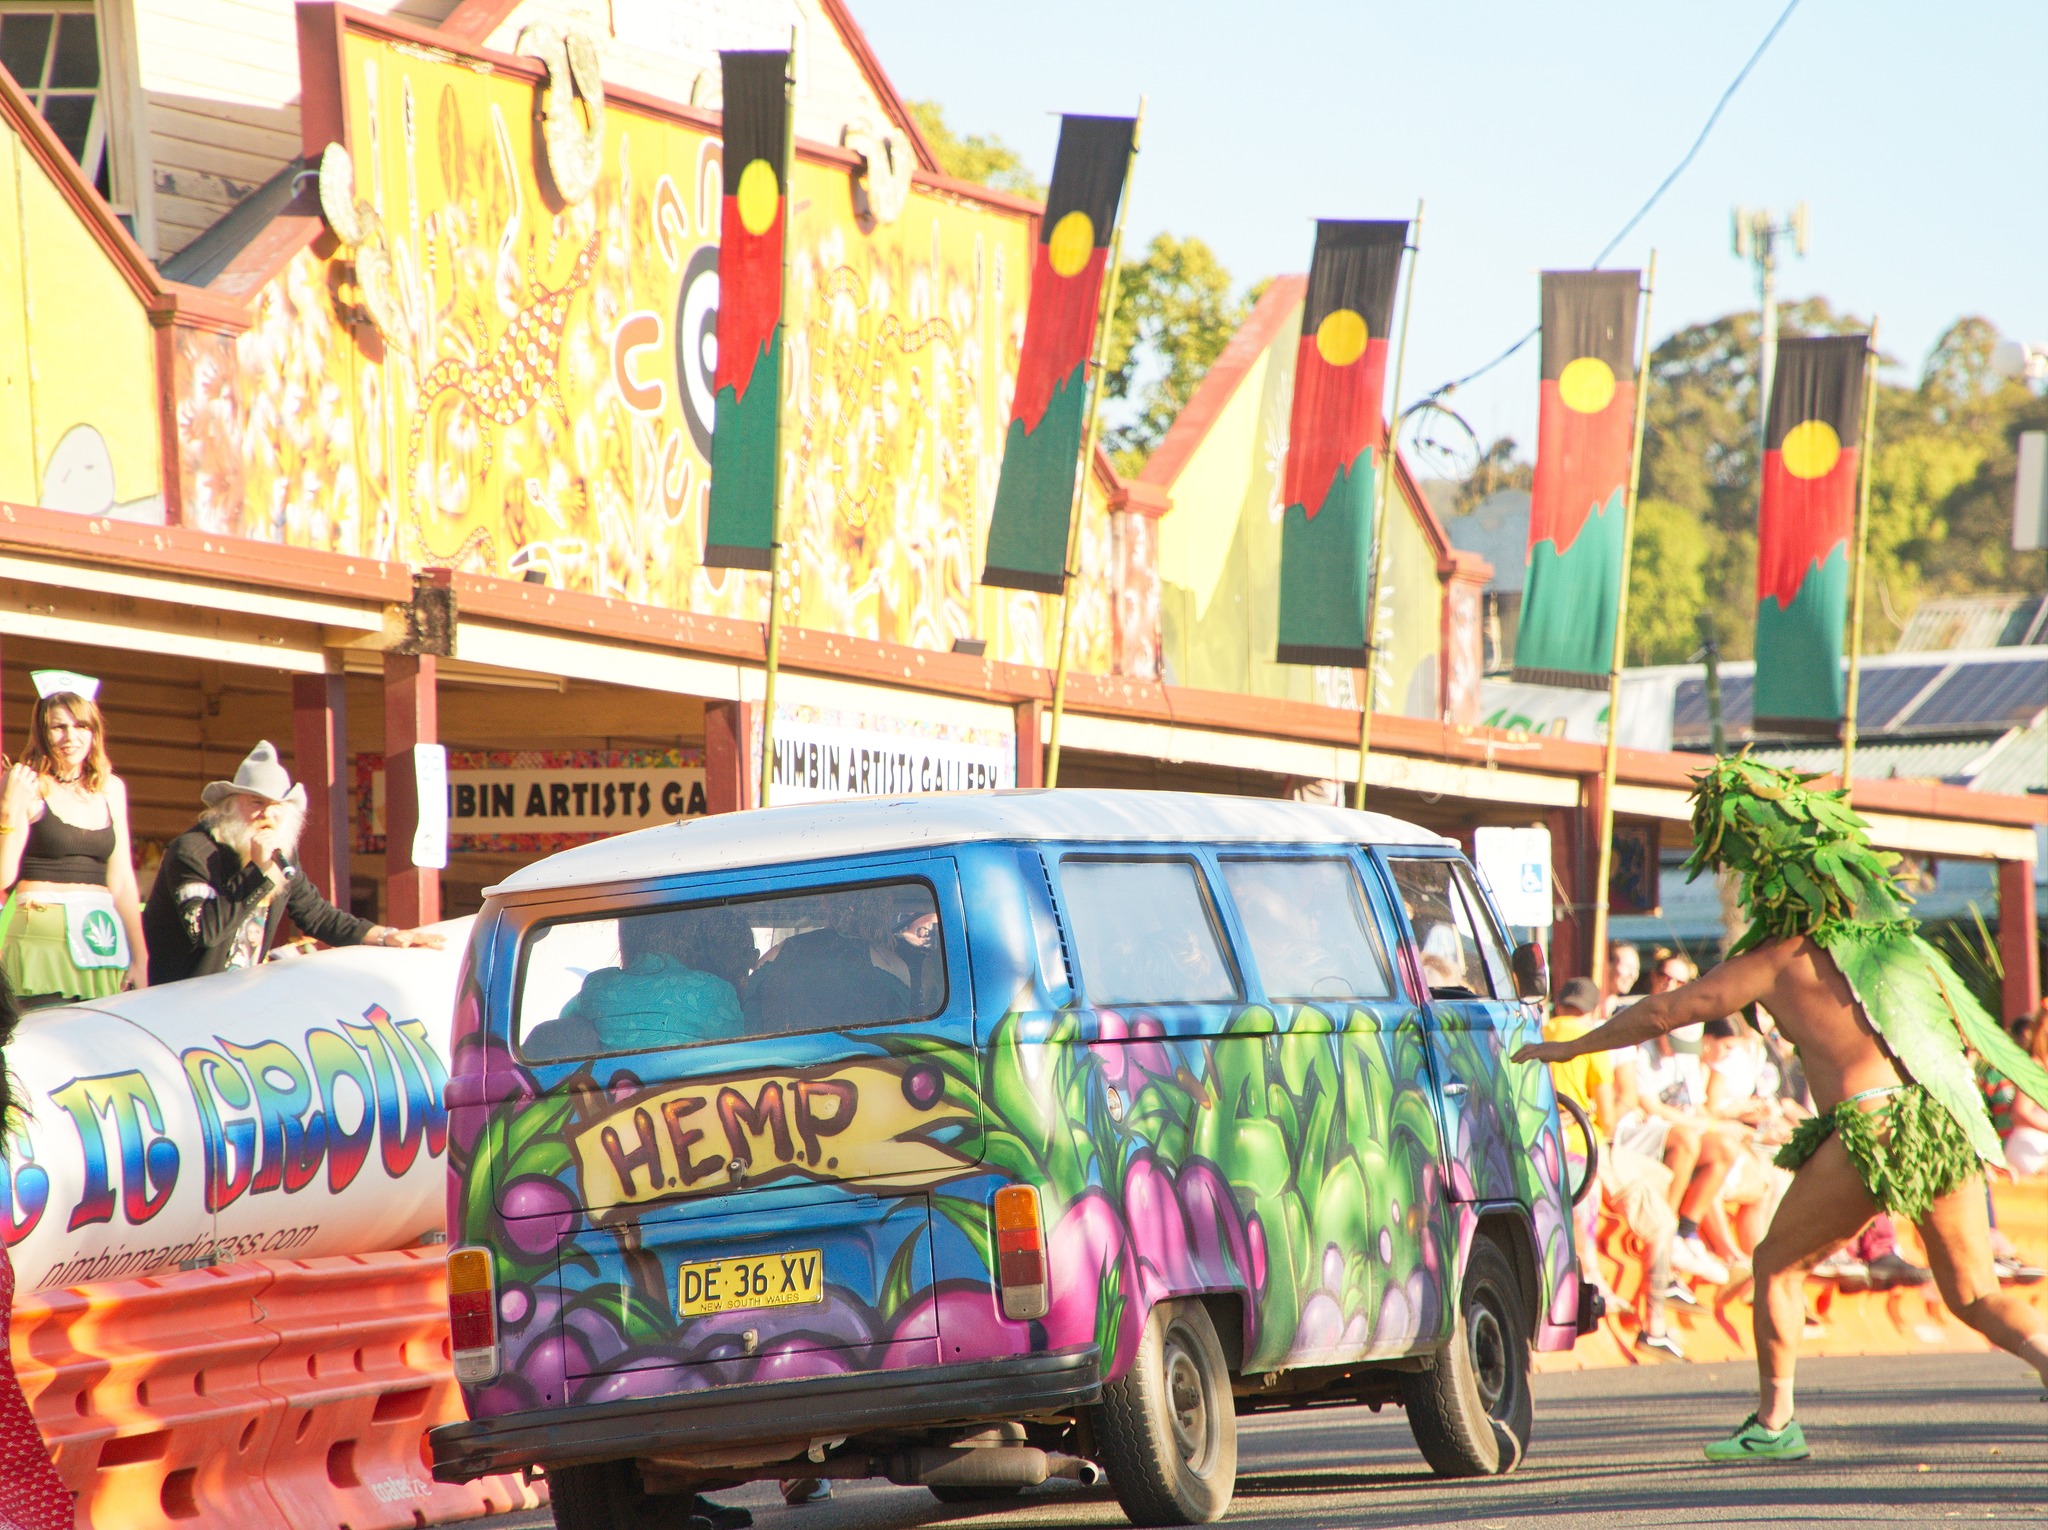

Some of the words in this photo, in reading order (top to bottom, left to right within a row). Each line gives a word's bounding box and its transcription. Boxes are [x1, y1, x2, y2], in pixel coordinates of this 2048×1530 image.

[772, 737, 840, 792] NIMBIN
[847, 748, 914, 795] ARTISTS
[525, 781, 651, 819] ARTISTS
[180, 1003, 448, 1214] GROW
[36, 1223, 320, 1289] nimbinmardigrass.com
[685, 1267, 722, 1304] DE
[734, 1263, 768, 1297] 36
[780, 1256, 816, 1292] XV
[700, 1301, 723, 1312] NEW
[727, 1297, 761, 1309] SOUTH
[765, 1292, 800, 1304] WALES
